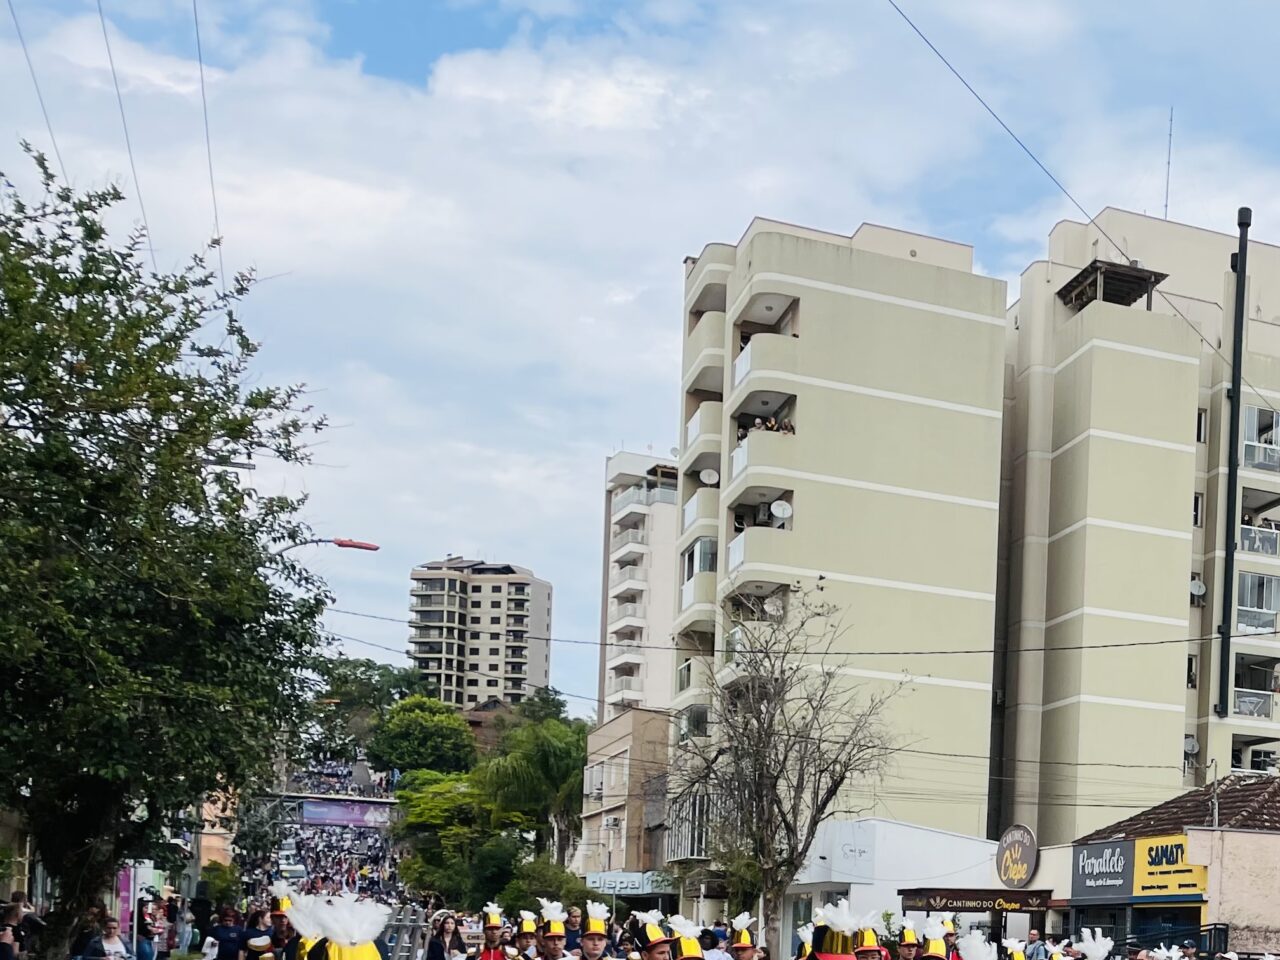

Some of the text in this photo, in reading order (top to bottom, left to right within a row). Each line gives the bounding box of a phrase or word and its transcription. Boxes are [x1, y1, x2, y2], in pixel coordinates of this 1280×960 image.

[1001, 849, 1028, 885] Crepe
[1079, 848, 1125, 876] Parallelo
[591, 876, 640, 892] dispa
[947, 899, 982, 908] CANTINHO
[982, 900, 994, 908] DO
[995, 898, 1020, 911] Crepe
